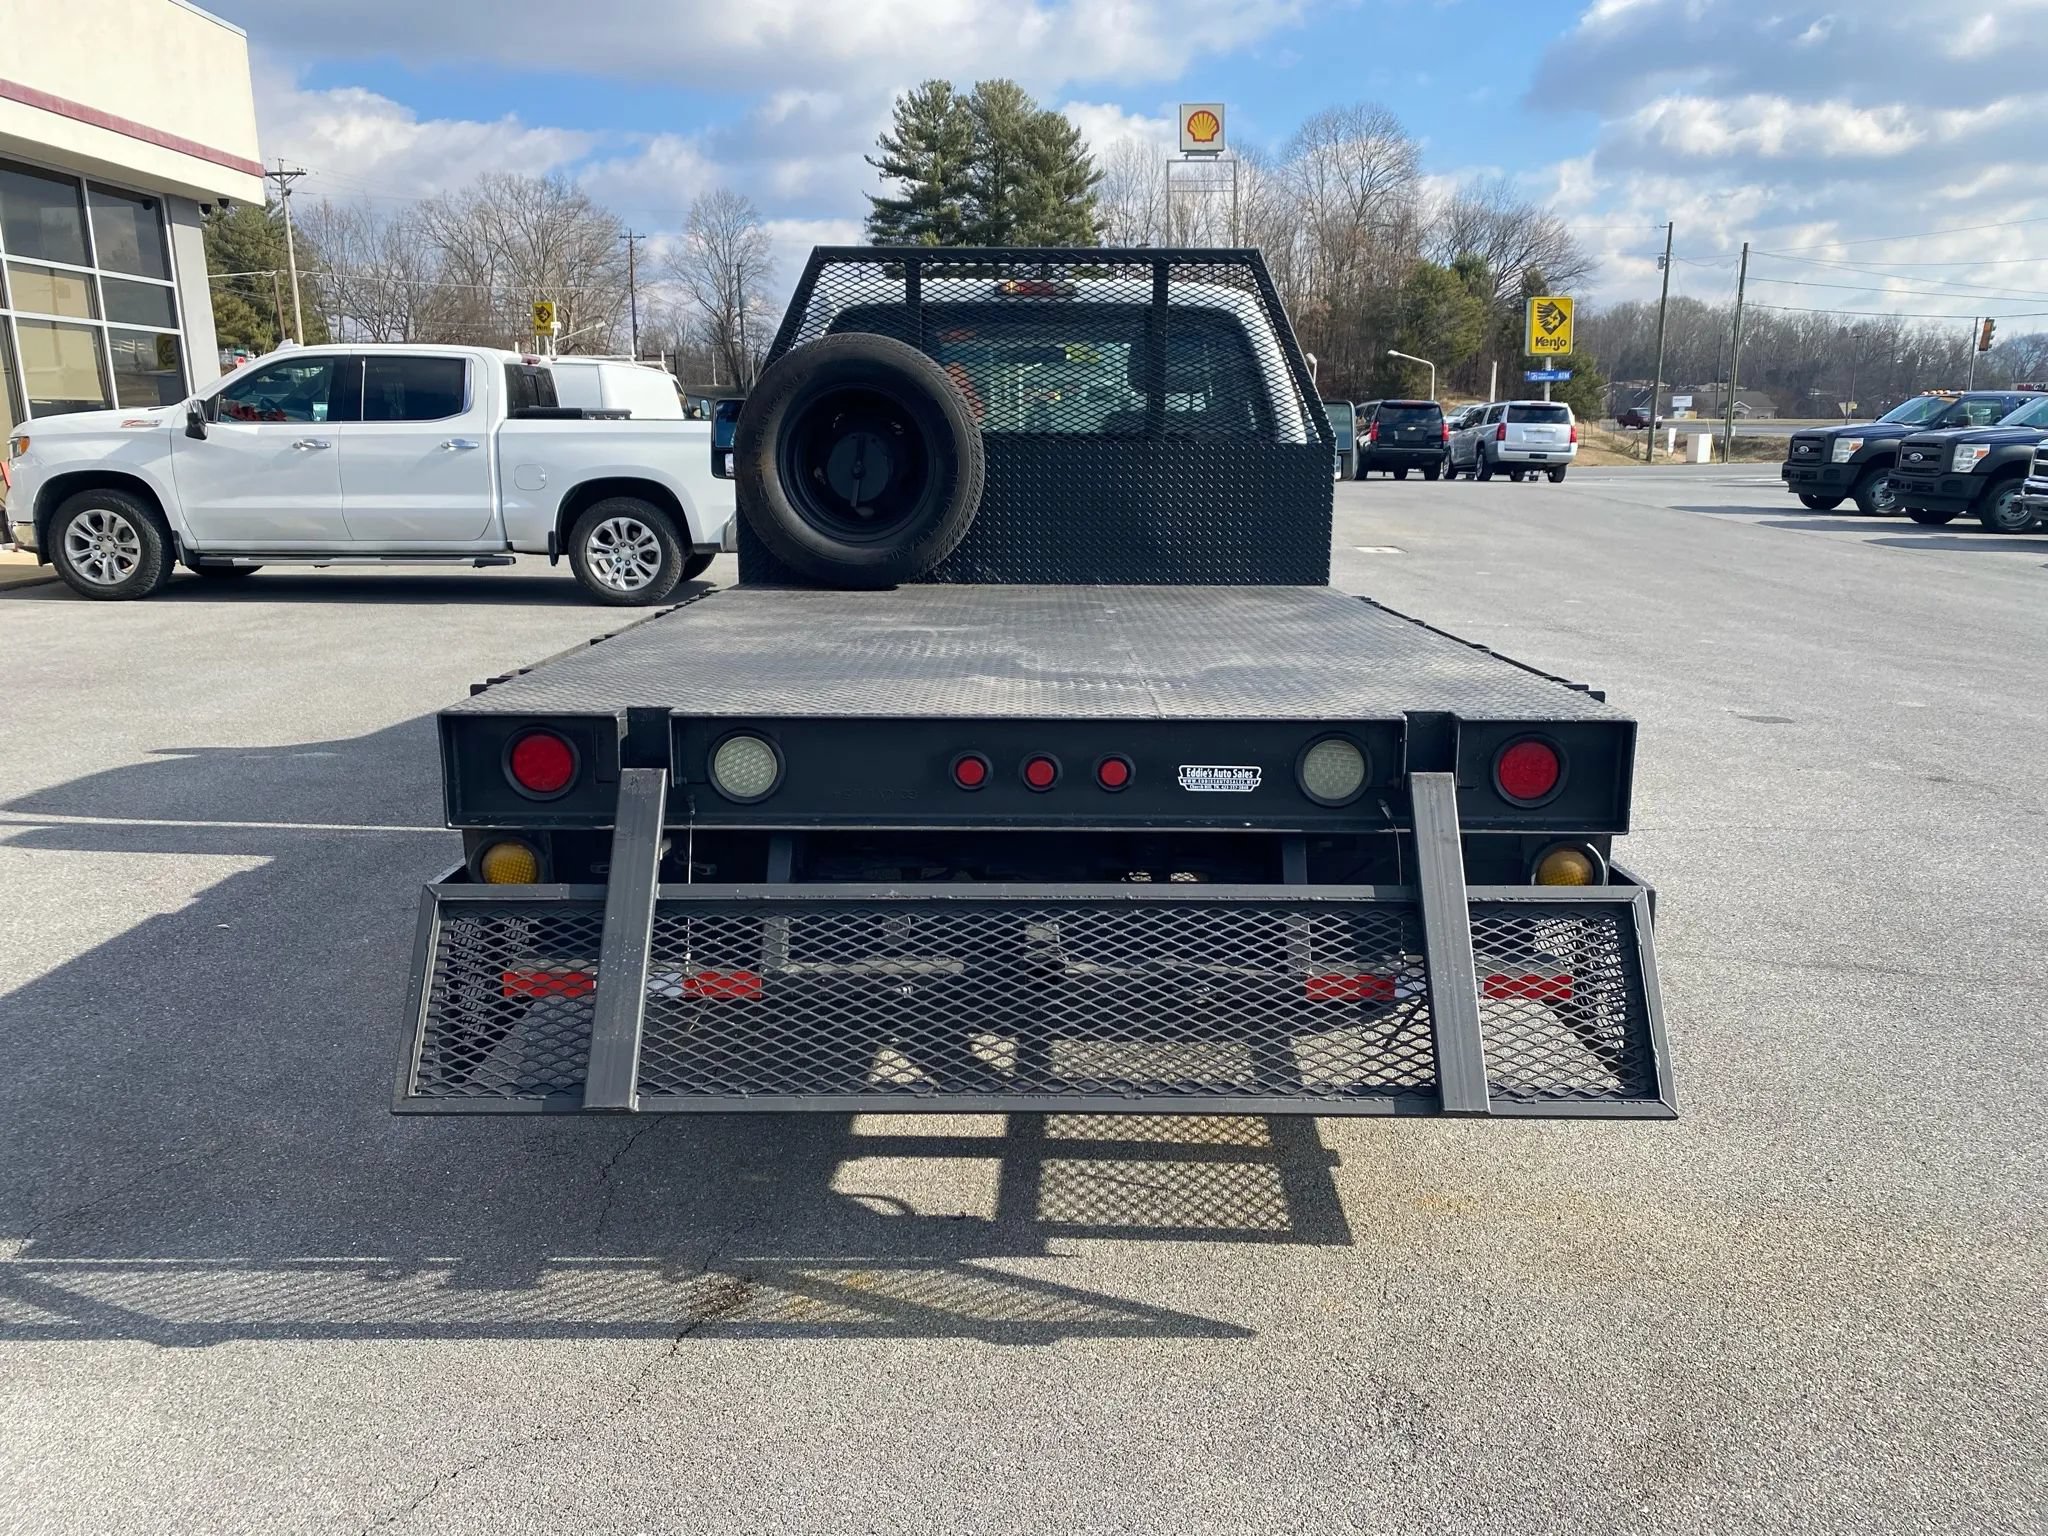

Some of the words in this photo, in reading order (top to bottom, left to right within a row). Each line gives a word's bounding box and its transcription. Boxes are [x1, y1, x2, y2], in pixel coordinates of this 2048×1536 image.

[1535, 336, 1567, 351] Kenjo
[1186, 767, 1212, 778] Eddie's
[1213, 768, 1232, 778] Auto
[1233, 768, 1253, 779] Sales
